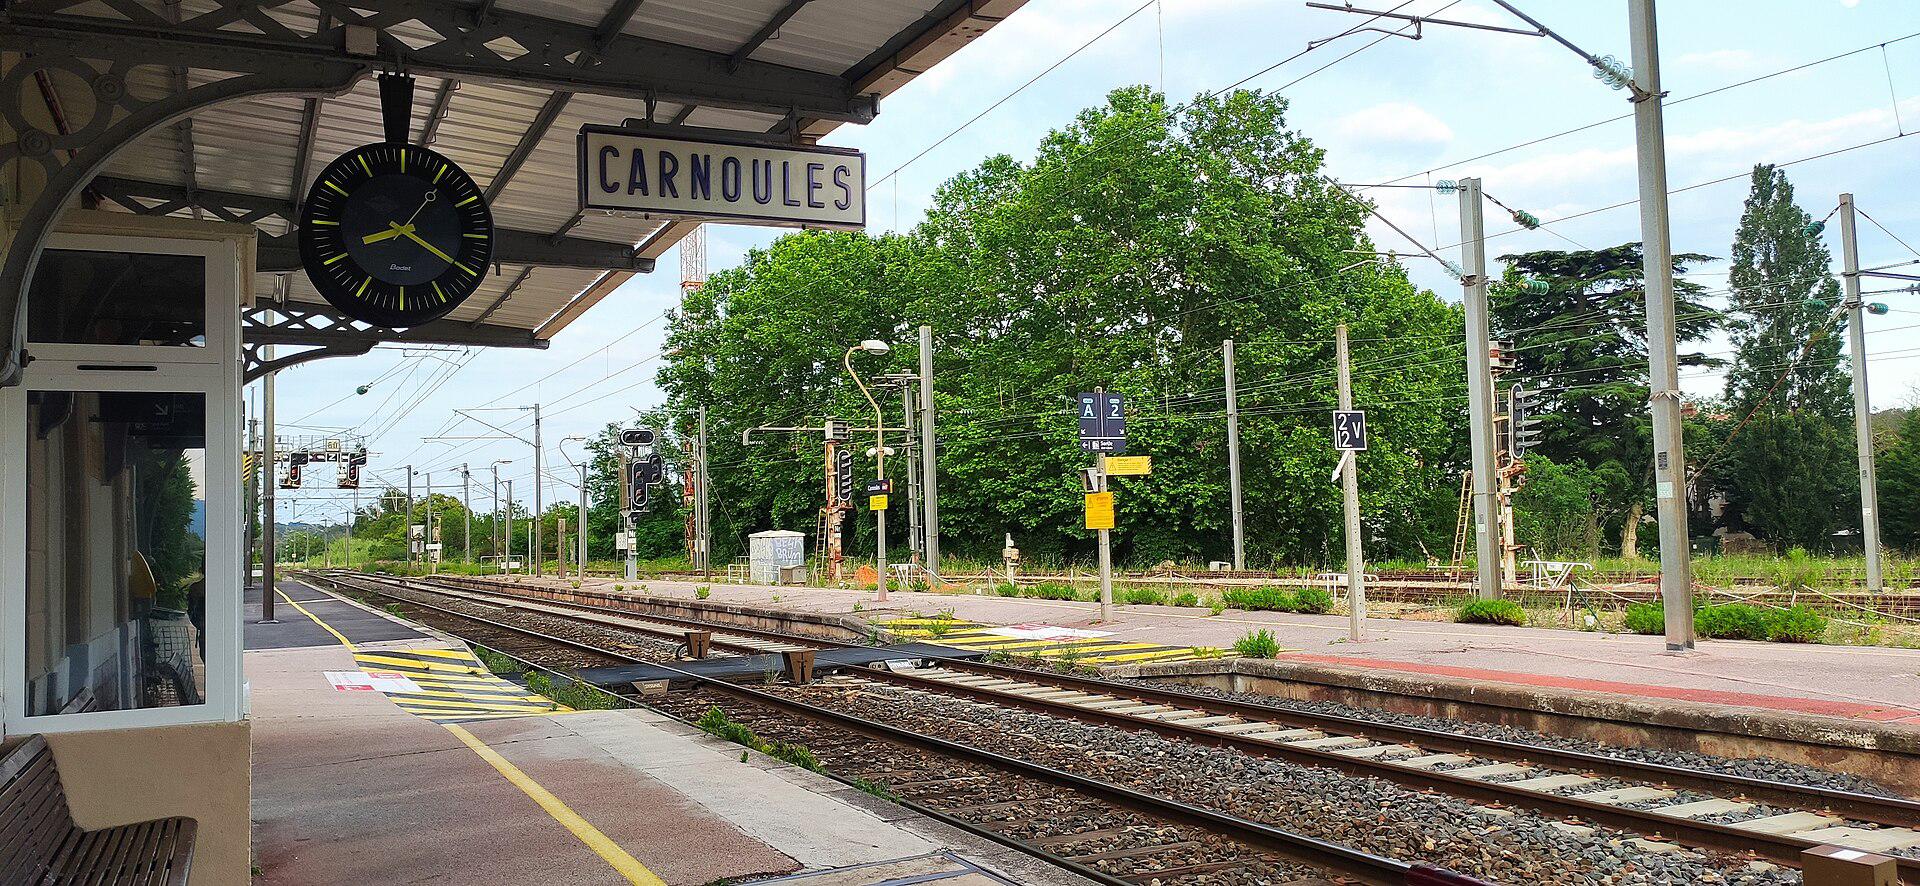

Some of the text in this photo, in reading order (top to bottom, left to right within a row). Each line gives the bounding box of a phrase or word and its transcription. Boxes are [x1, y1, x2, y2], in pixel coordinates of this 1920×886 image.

[599, 145, 852, 210] CARNOULES
[1083, 404, 1094, 417] A
[1110, 404, 1120, 417] 2
[1337, 430, 1353, 448] 12
[1351, 421, 1361, 439] V
